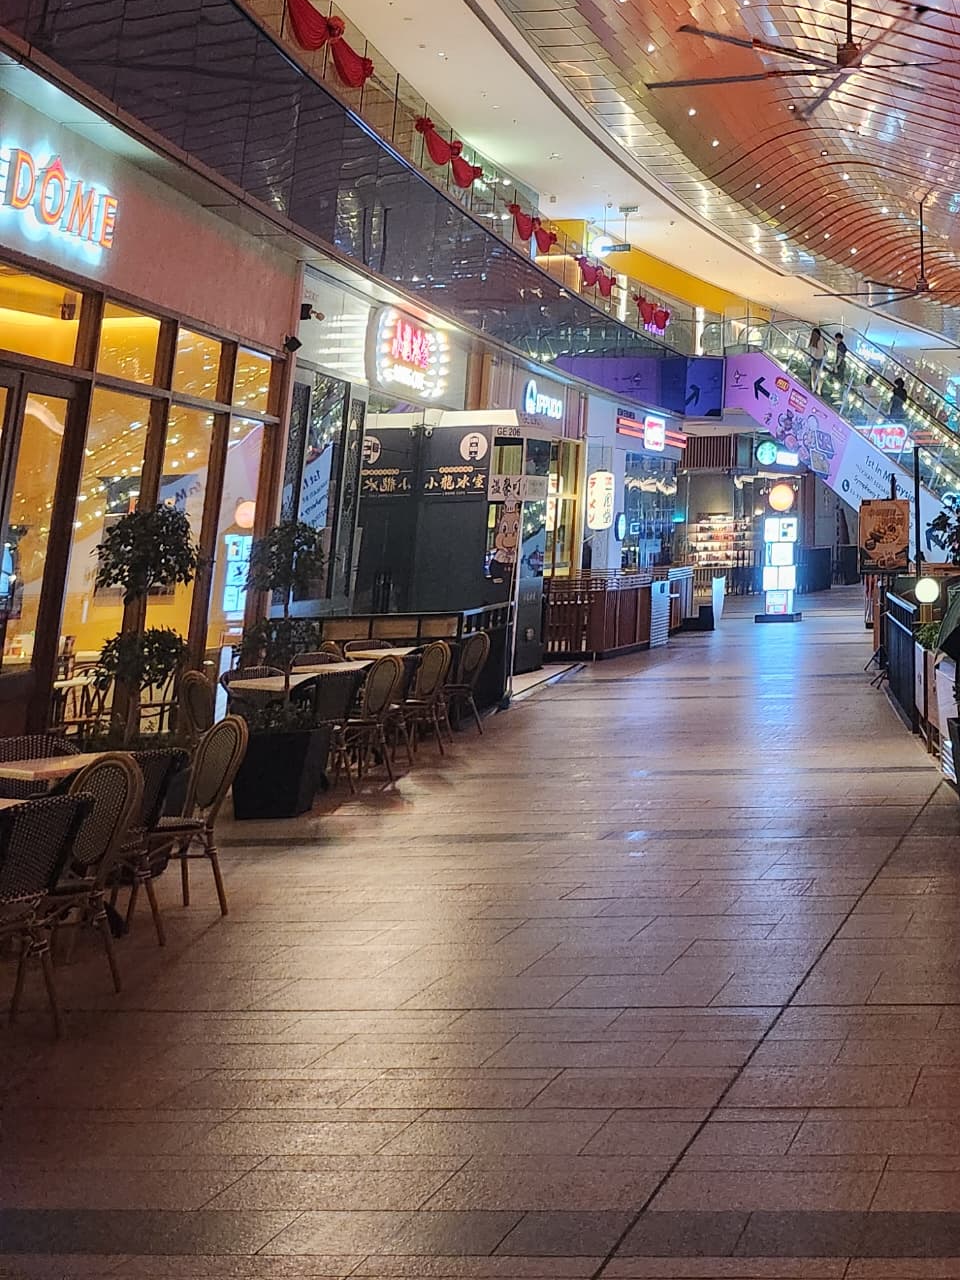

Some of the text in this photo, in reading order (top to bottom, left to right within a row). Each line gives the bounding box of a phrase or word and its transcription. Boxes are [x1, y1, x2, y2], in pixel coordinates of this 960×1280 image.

[536, 393, 563, 420] IPPUDO
[497, 427, 521, 437] GE 206
[424, 473, 486, 491] 小龍冰室
[883, 469, 915, 503] Maysia
